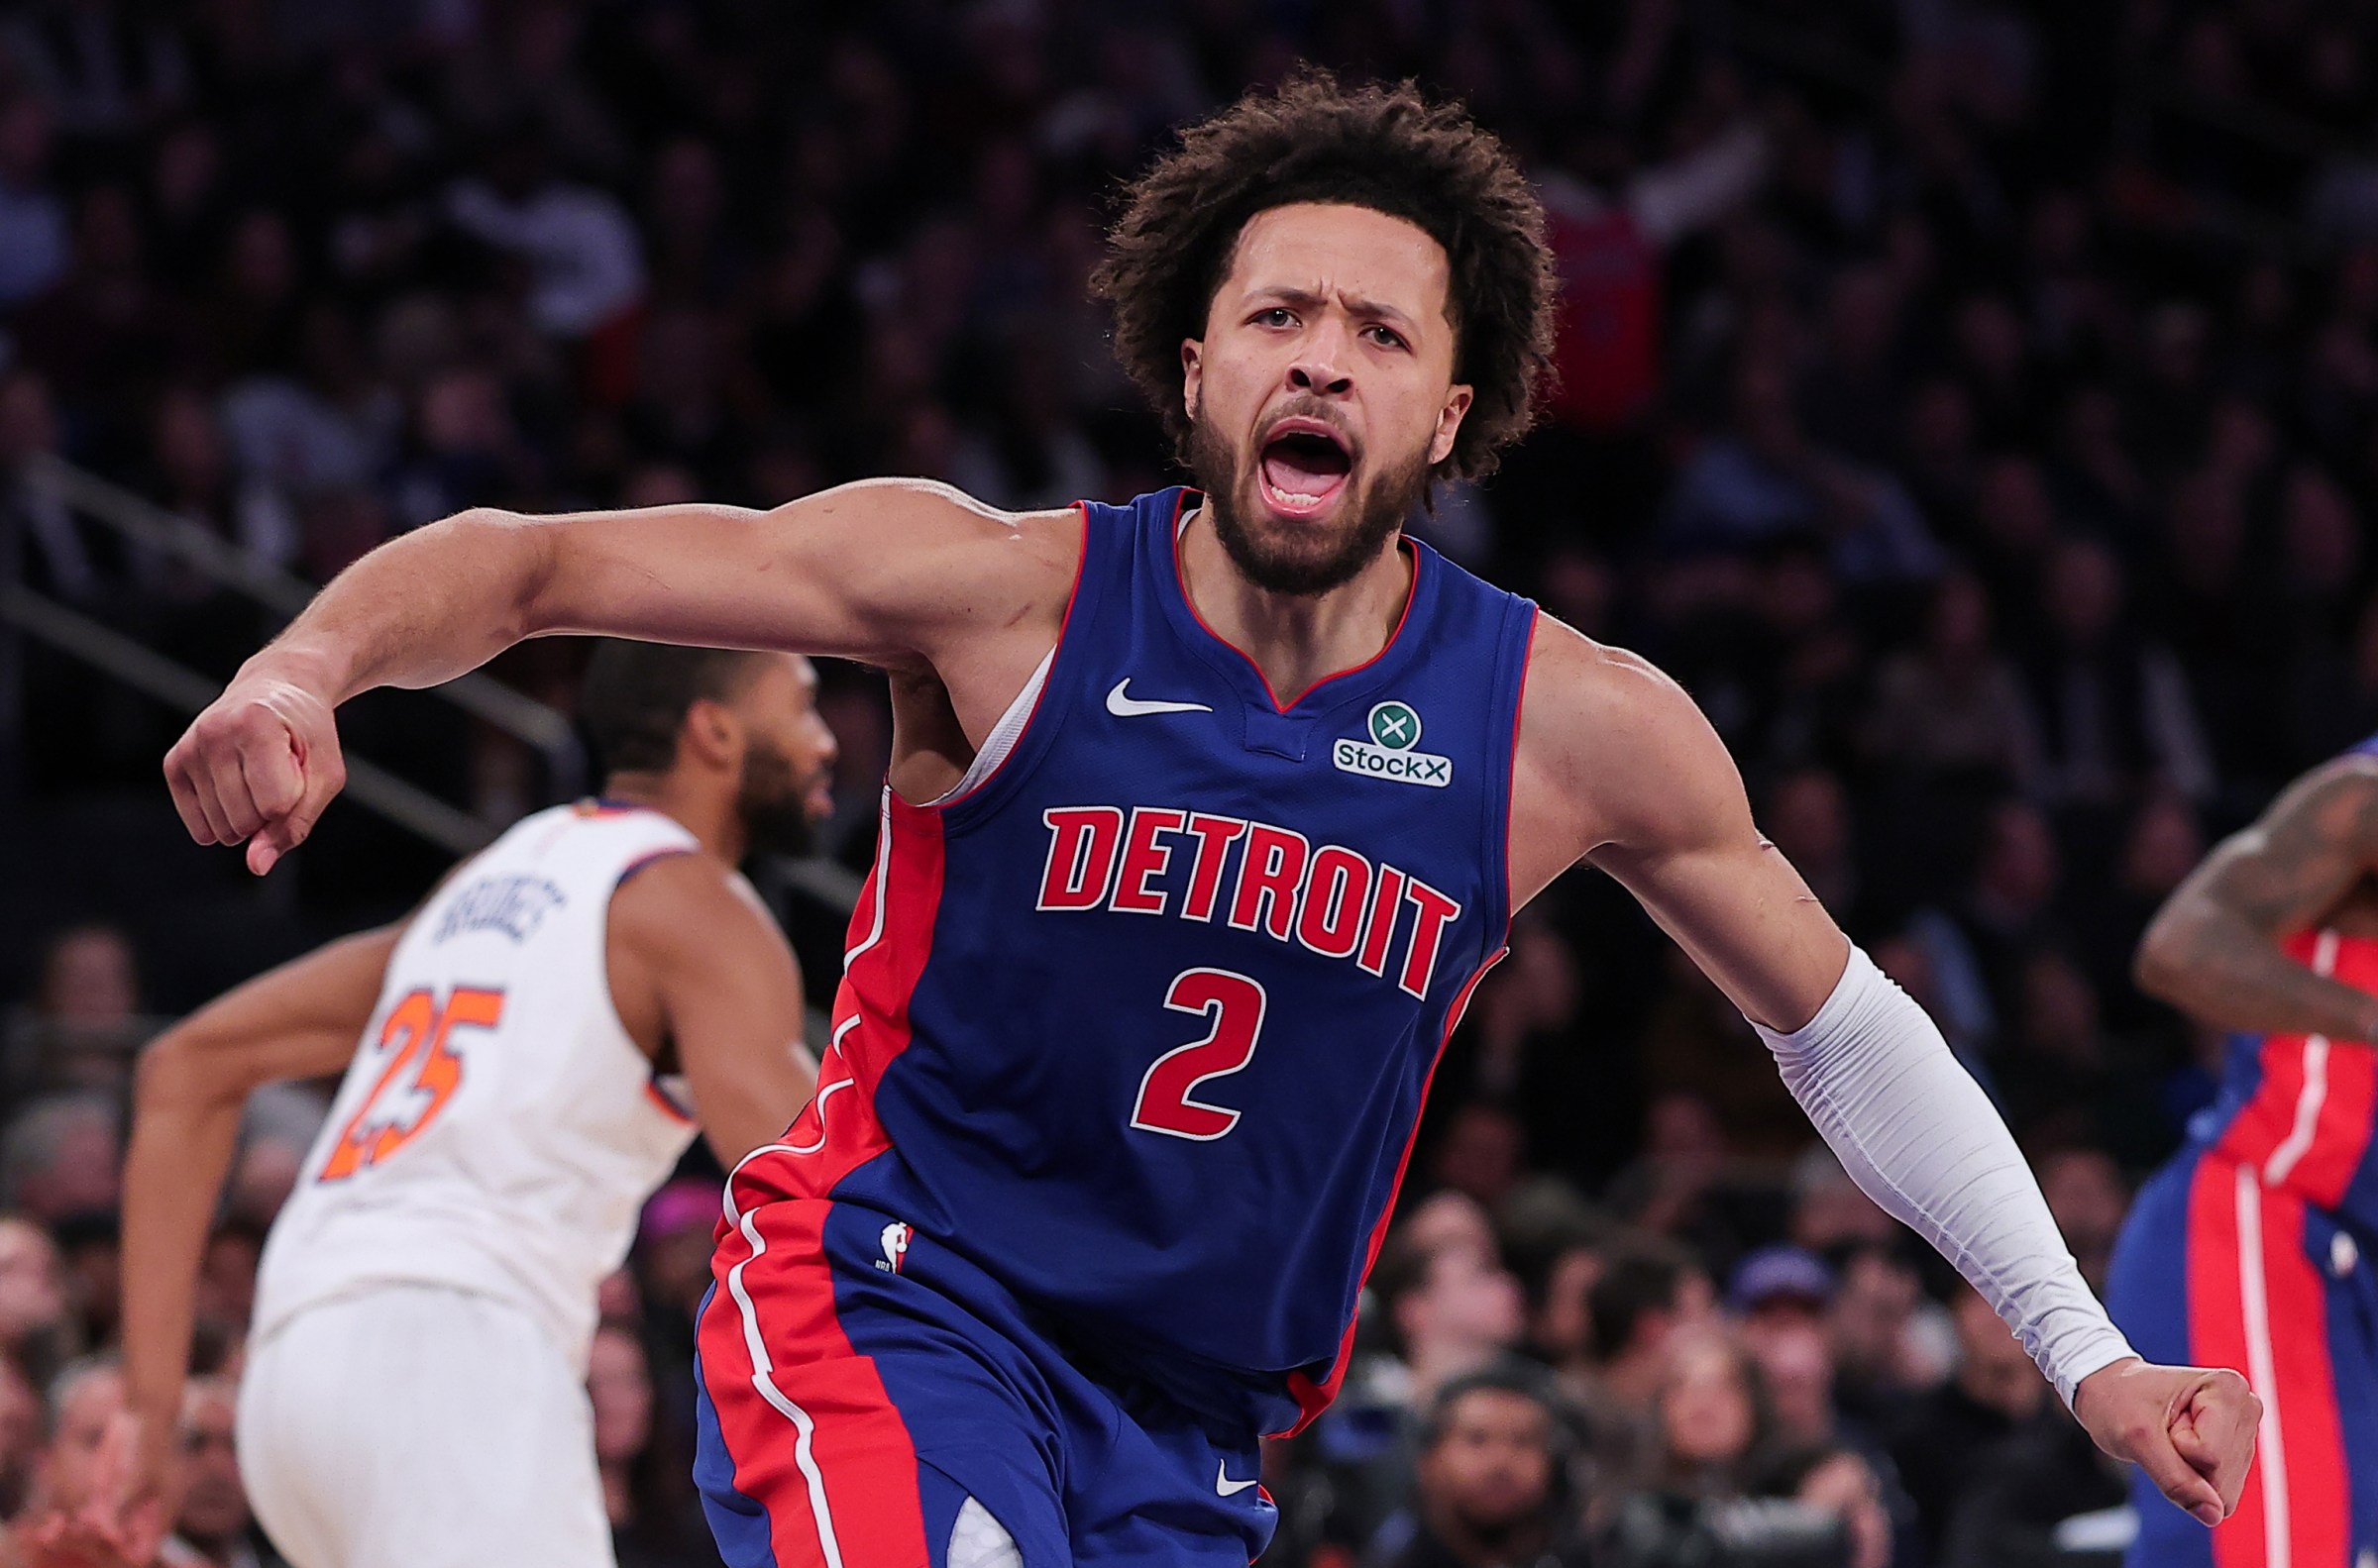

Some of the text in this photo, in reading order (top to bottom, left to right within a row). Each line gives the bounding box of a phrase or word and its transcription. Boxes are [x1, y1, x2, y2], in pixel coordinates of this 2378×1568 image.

[1338, 744, 1448, 783] StockX
[1035, 805, 1461, 1001] DETROIT
[315, 986, 506, 1182] 25
[1130, 967, 1266, 1141] 2
